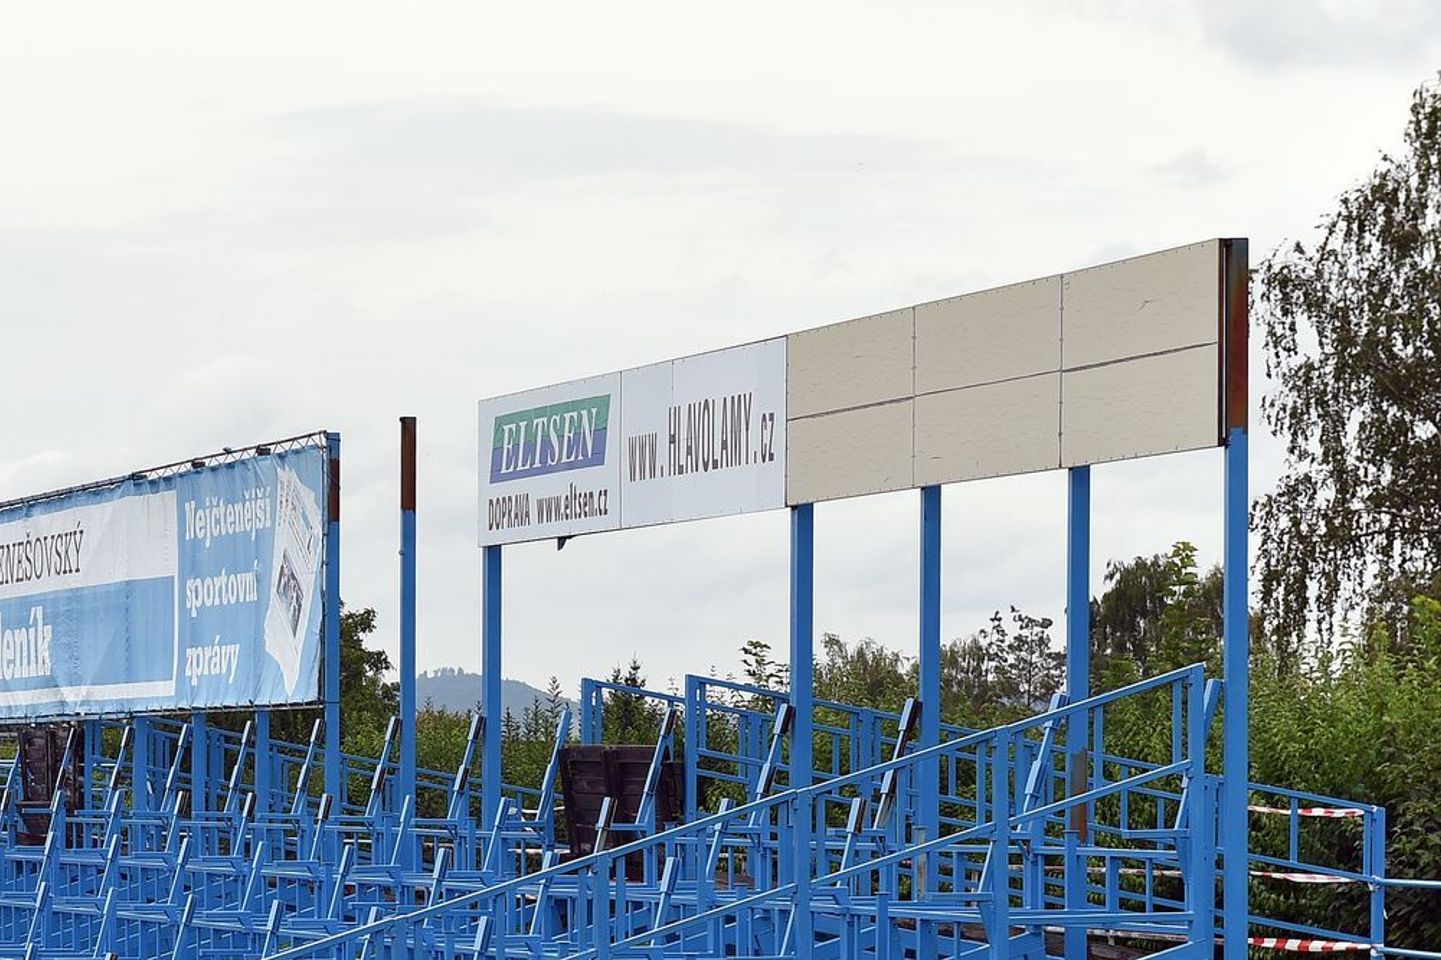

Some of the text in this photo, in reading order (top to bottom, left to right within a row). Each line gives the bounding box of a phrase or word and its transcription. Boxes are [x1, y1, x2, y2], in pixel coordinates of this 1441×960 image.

[499, 407, 598, 474] ELTSEN
[185, 487, 271, 548] Nejčtenější
[488, 482, 609, 531] DOPRAVA www.eltsen.cz
[186, 559, 260, 618] sportovní
[185, 635, 240, 686] zprávy
